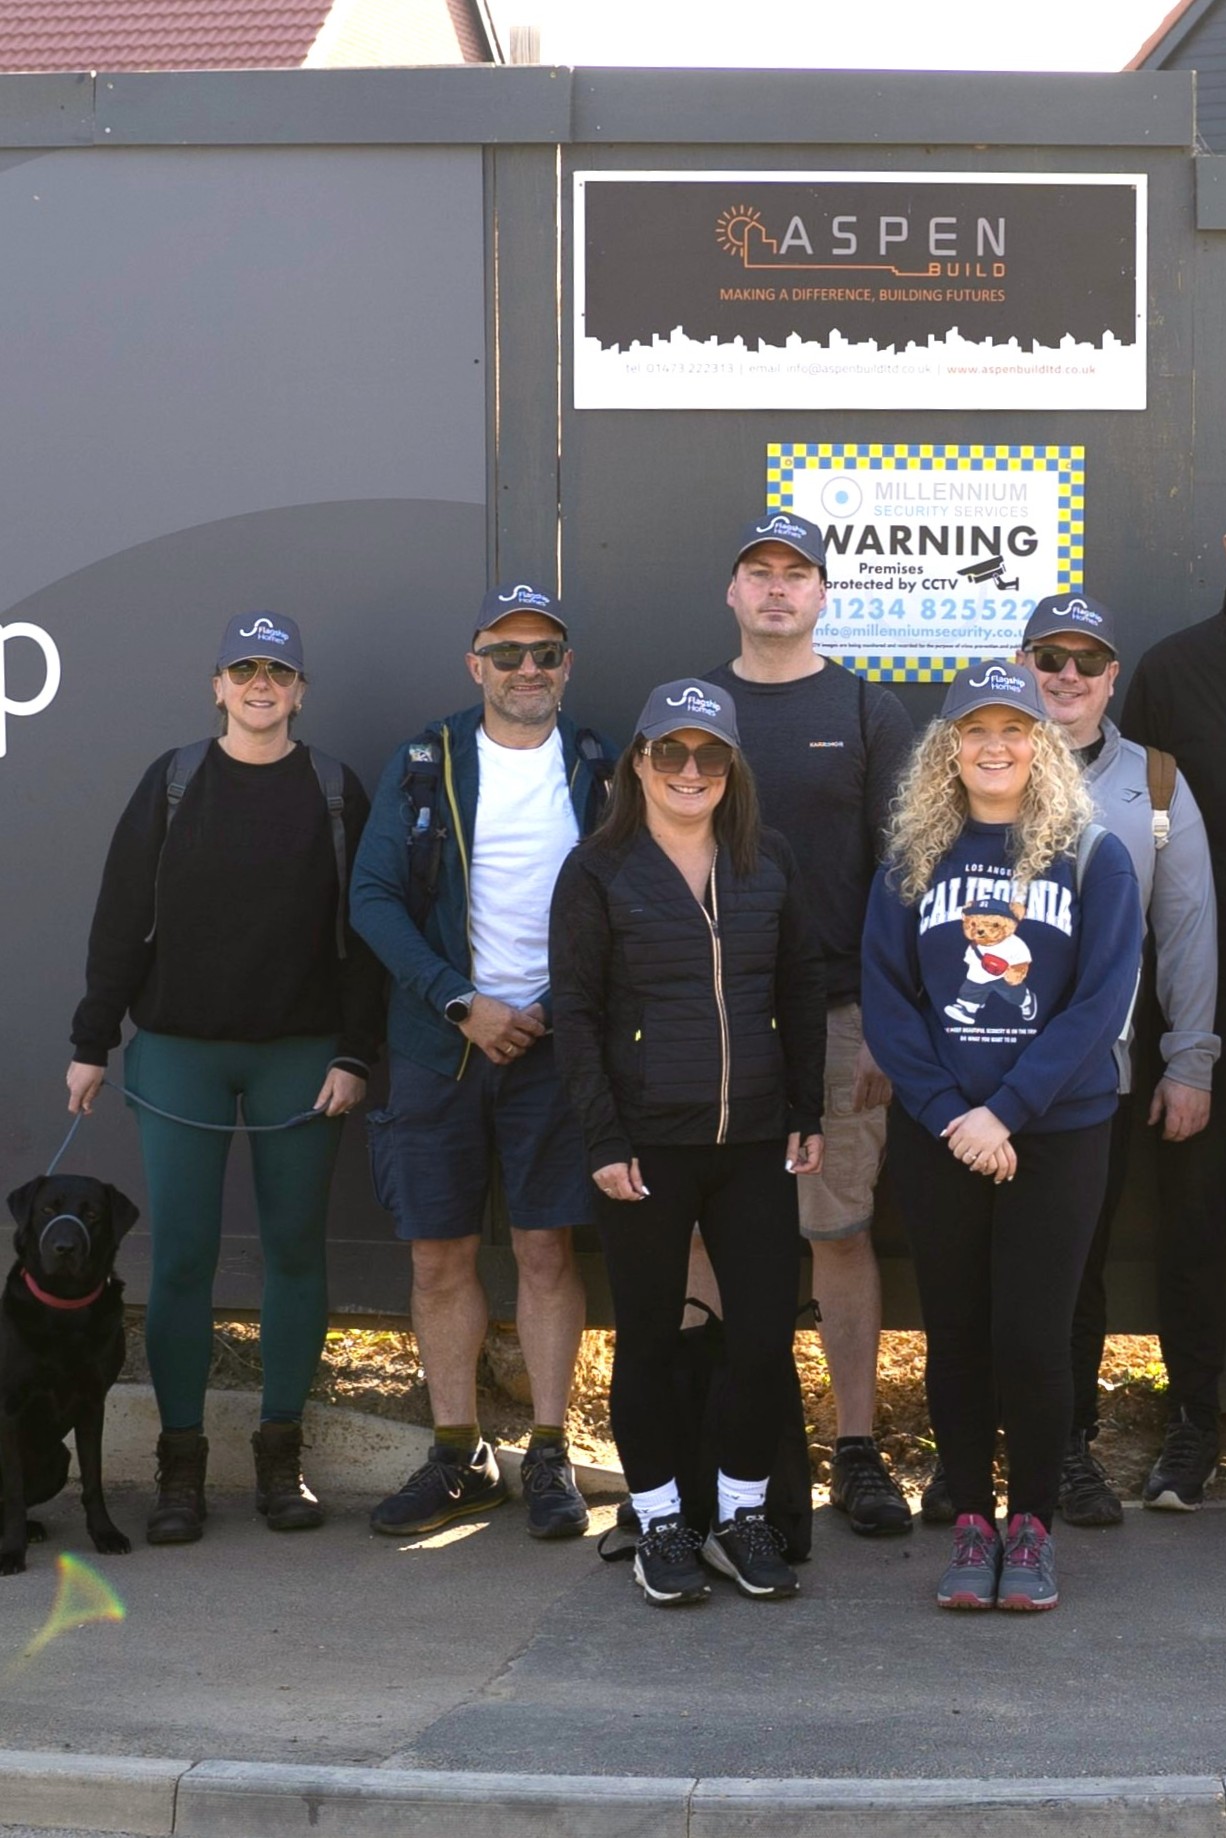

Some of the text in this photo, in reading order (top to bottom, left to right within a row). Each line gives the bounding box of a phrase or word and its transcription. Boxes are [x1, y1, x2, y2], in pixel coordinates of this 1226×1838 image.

[779, 215, 1005, 256] ASPEN
[929, 263, 1005, 277] BUILD
[720, 288, 1005, 303] MAKING A DIFFERENCE, BUILDING FUTURES
[646, 363, 685, 373] 01473
[688, 363, 734, 373] 222313
[947, 365, 1096, 376] www.aspenbuildltd.co.uk
[875, 482, 1028, 501] MILLENNIUM
[874, 505, 1029, 518] SECURITY SERVICES
[774, 528, 802, 539] Homes
[775, 522, 807, 536] Flagship
[822, 524, 1039, 557] WARNING
[859, 562, 924, 575] Premises
[898, 578, 917, 593] by
[921, 579, 959, 590] CCTV
[920, 598, 1036, 621] 825522
[1073, 606, 1103, 623] Flagship
[1072, 612, 1098, 626] Homes
[258, 626, 289, 641] Flagship
[816, 624, 1023, 640] nfo@millenniumsecurity.co.u
[258, 634, 285, 645] Homes
[991, 675, 1025, 688] Flagship
[991, 682, 1021, 693] Homes
[687, 704, 716, 716] Homes
[688, 696, 721, 711] Flagship
[965, 863, 1014, 876] LOS ANGE
